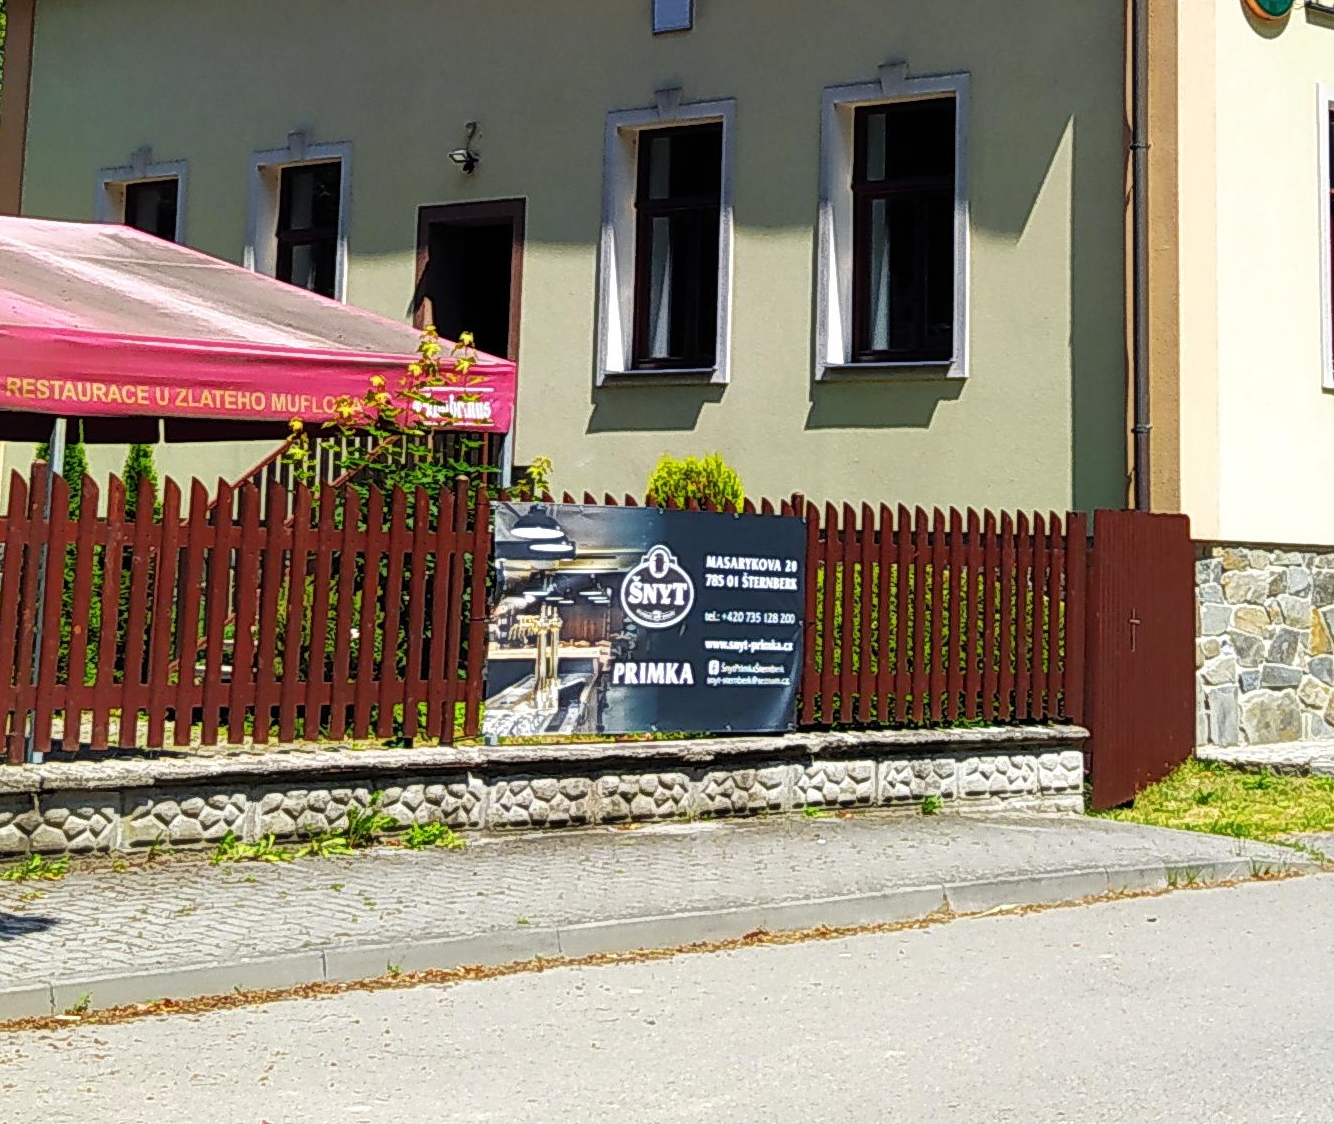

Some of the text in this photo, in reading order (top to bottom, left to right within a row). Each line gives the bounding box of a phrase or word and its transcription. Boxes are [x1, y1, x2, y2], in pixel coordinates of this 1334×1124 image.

[5, 377, 151, 405] RESTAURACE
[156, 389, 169, 406] U
[271, 393, 364, 414] MUFLOA
[706, 555, 798, 572] MASARYKOVA 20
[628, 576, 687, 605] ŠNYT
[705, 572, 798, 590] 785 01 ŠTERNBERK
[705, 611, 796, 624] tel.: +420 735 128 200
[612, 661, 694, 685] PRIMKA
